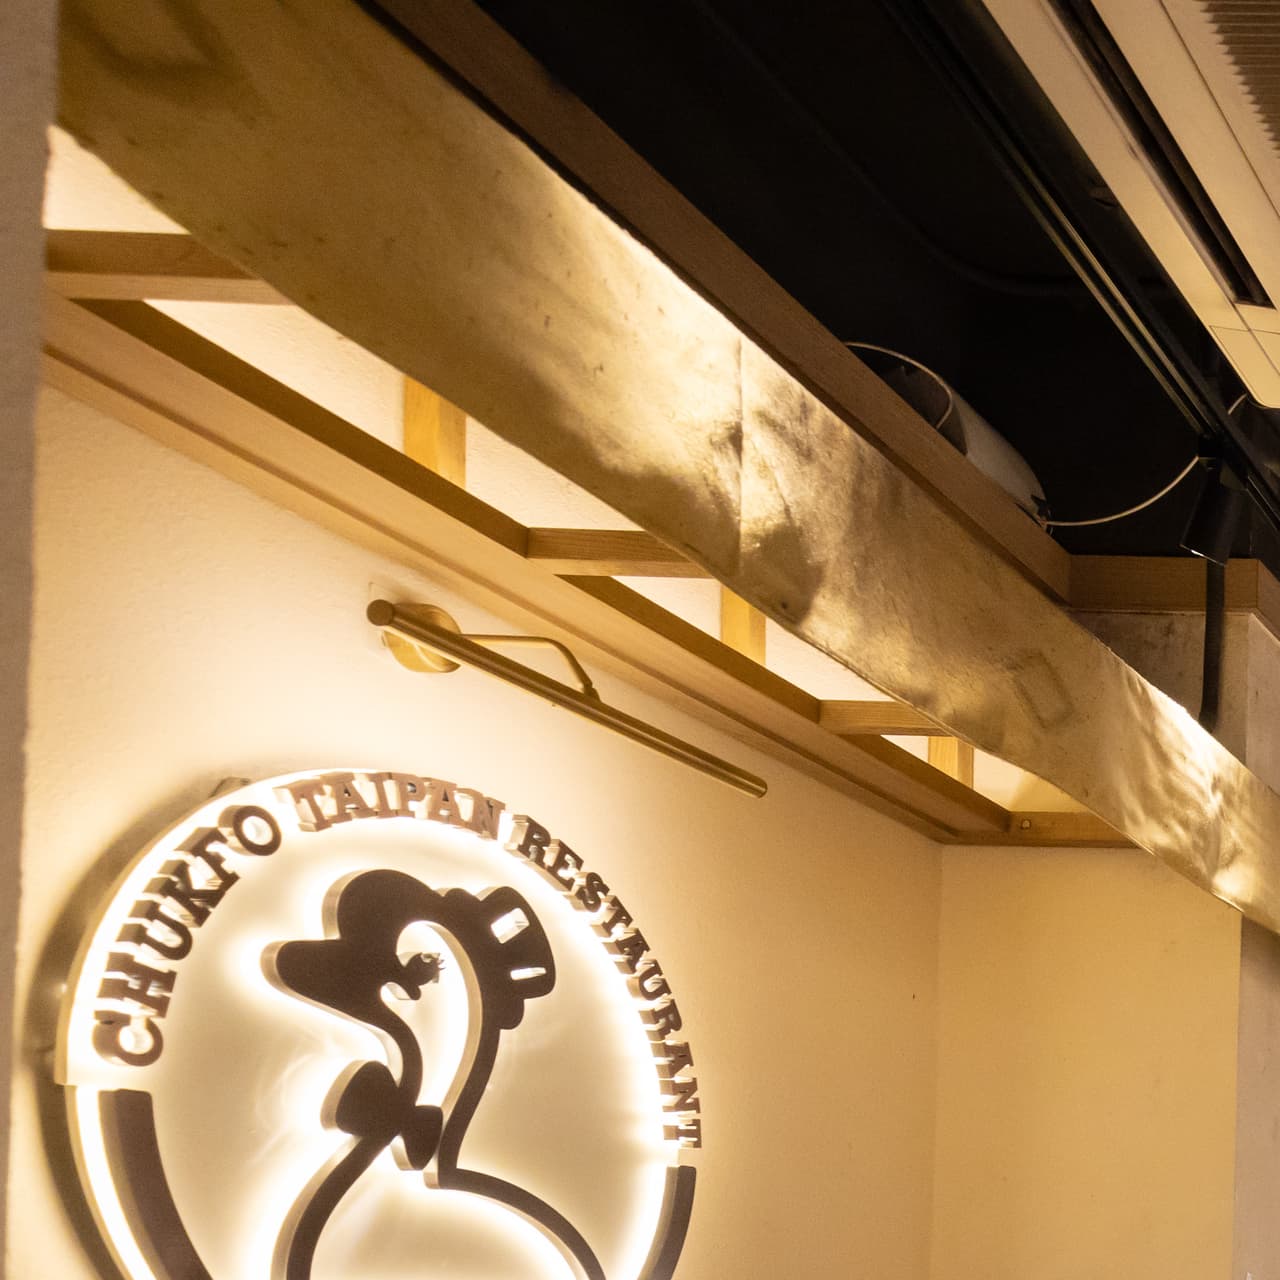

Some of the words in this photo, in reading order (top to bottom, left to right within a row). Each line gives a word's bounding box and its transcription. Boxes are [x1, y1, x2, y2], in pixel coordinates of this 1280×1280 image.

[93, 804, 283, 1068] CHUKFO
[278, 771, 505, 841] TAIPAN
[506, 813, 702, 1150] RESTAURANT
